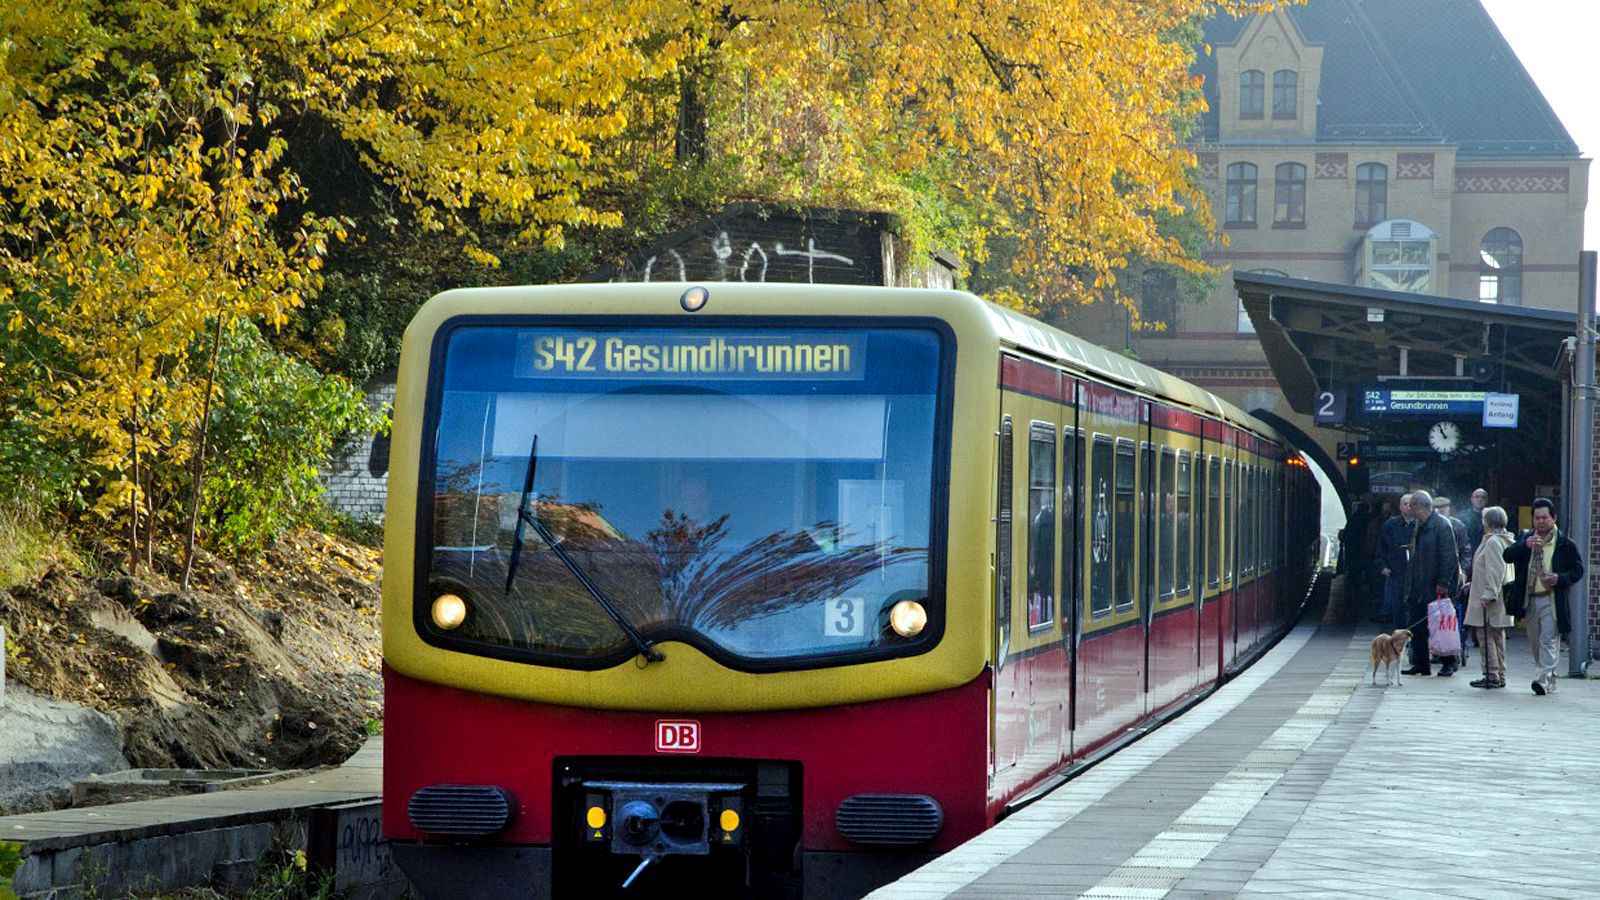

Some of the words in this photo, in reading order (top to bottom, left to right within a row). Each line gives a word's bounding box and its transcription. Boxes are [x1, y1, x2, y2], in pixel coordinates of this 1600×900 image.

[534, 336, 597, 371] S42
[605, 337, 851, 373] Gesundbrunnen
[1318, 392, 1335, 416] 2
[1390, 401, 1449, 410] Gesundbrunnen
[835, 599, 855, 633] 3
[661, 725, 695, 747] DB
